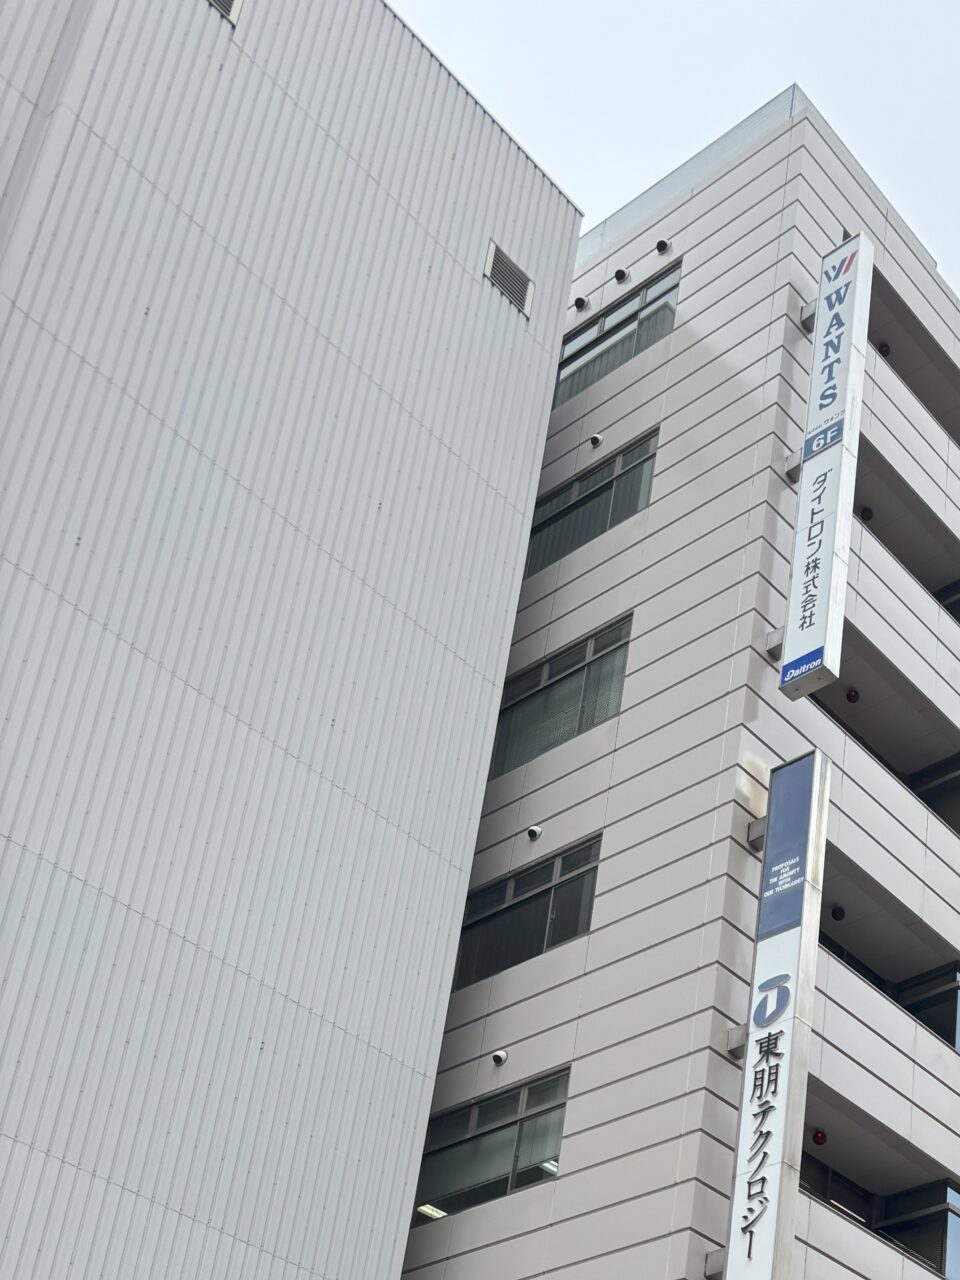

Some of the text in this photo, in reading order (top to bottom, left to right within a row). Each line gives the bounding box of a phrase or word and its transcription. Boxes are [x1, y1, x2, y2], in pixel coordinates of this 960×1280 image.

[818, 281, 852, 411] WANTS
[812, 426, 838, 451] 6F
[798, 467, 834, 631] ダイトロン株式会社
[784, 659, 822, 681] Daitron
[771, 856, 800, 873] PROPOSALS
[741, 1030, 784, 1260] 東朋テクノロジー
